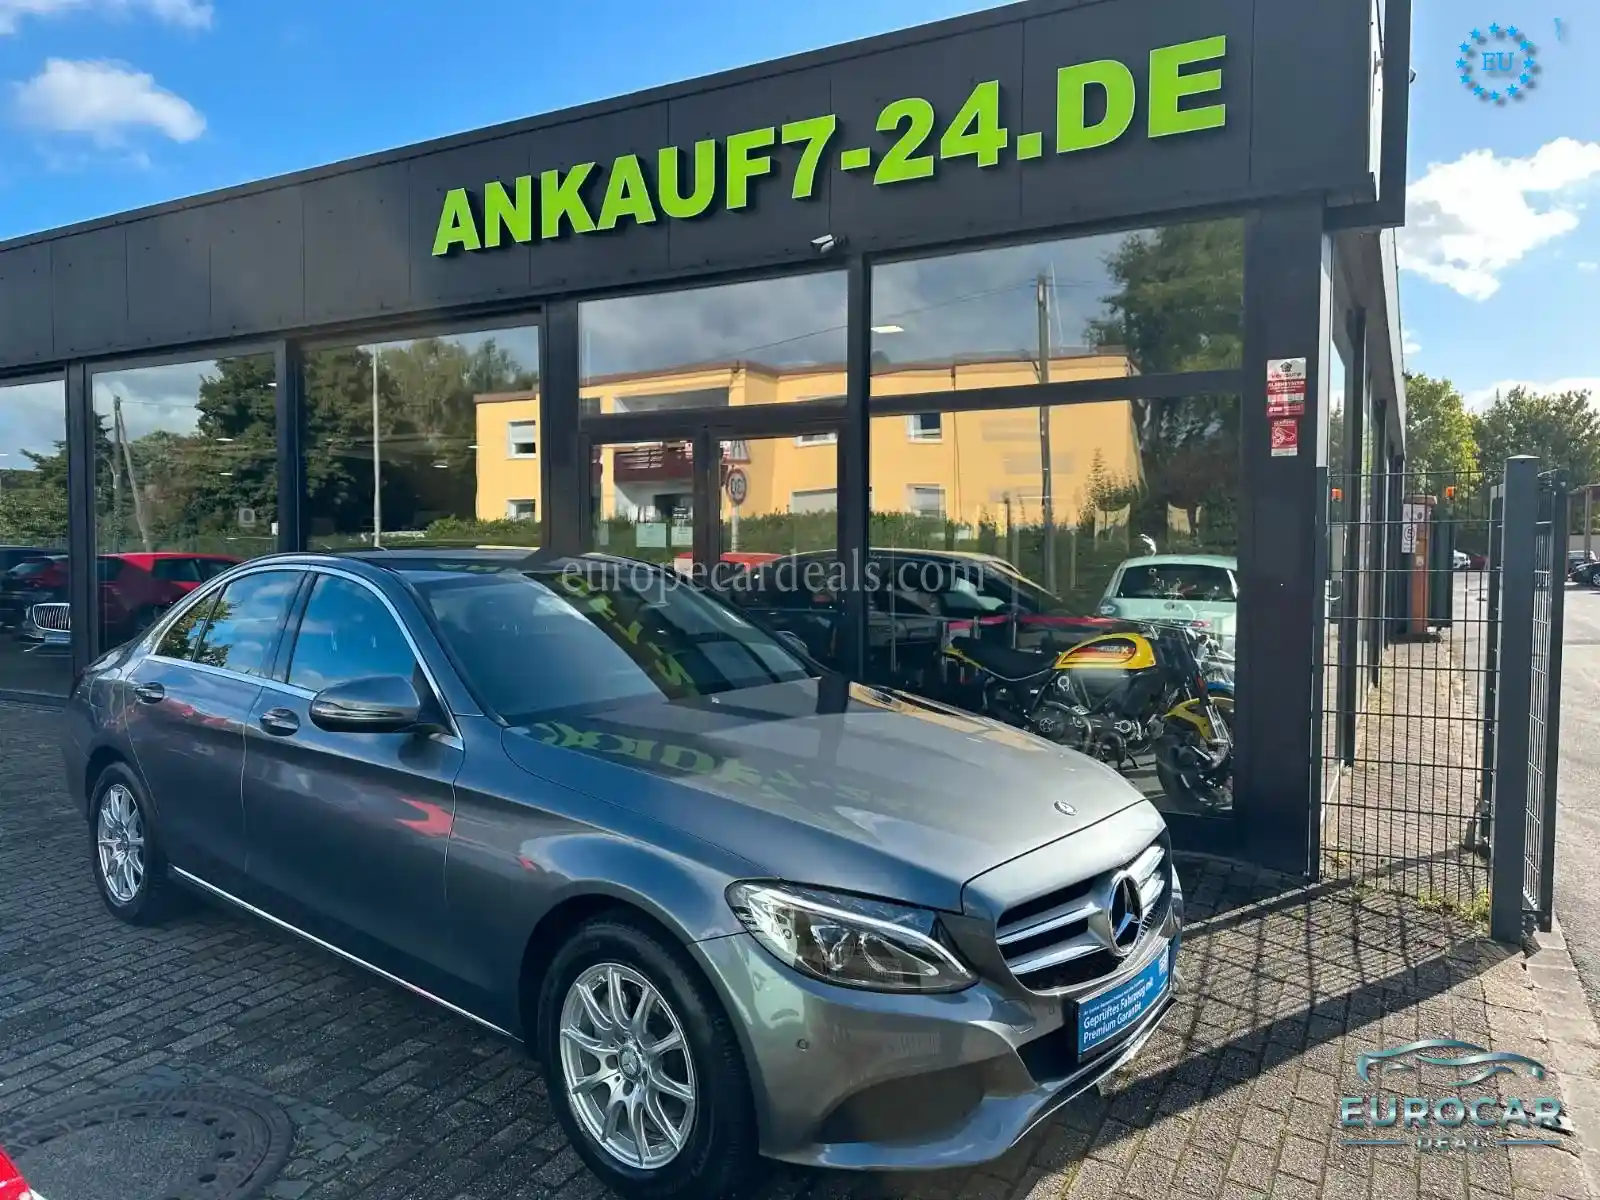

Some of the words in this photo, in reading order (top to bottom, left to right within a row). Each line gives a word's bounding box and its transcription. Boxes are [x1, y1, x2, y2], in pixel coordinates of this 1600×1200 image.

[431, 35, 1226, 256] ANKAUF7-24.DE
[1083, 1002, 1120, 1029] Geprüftes
[1083, 1018, 1116, 1044] Premium
